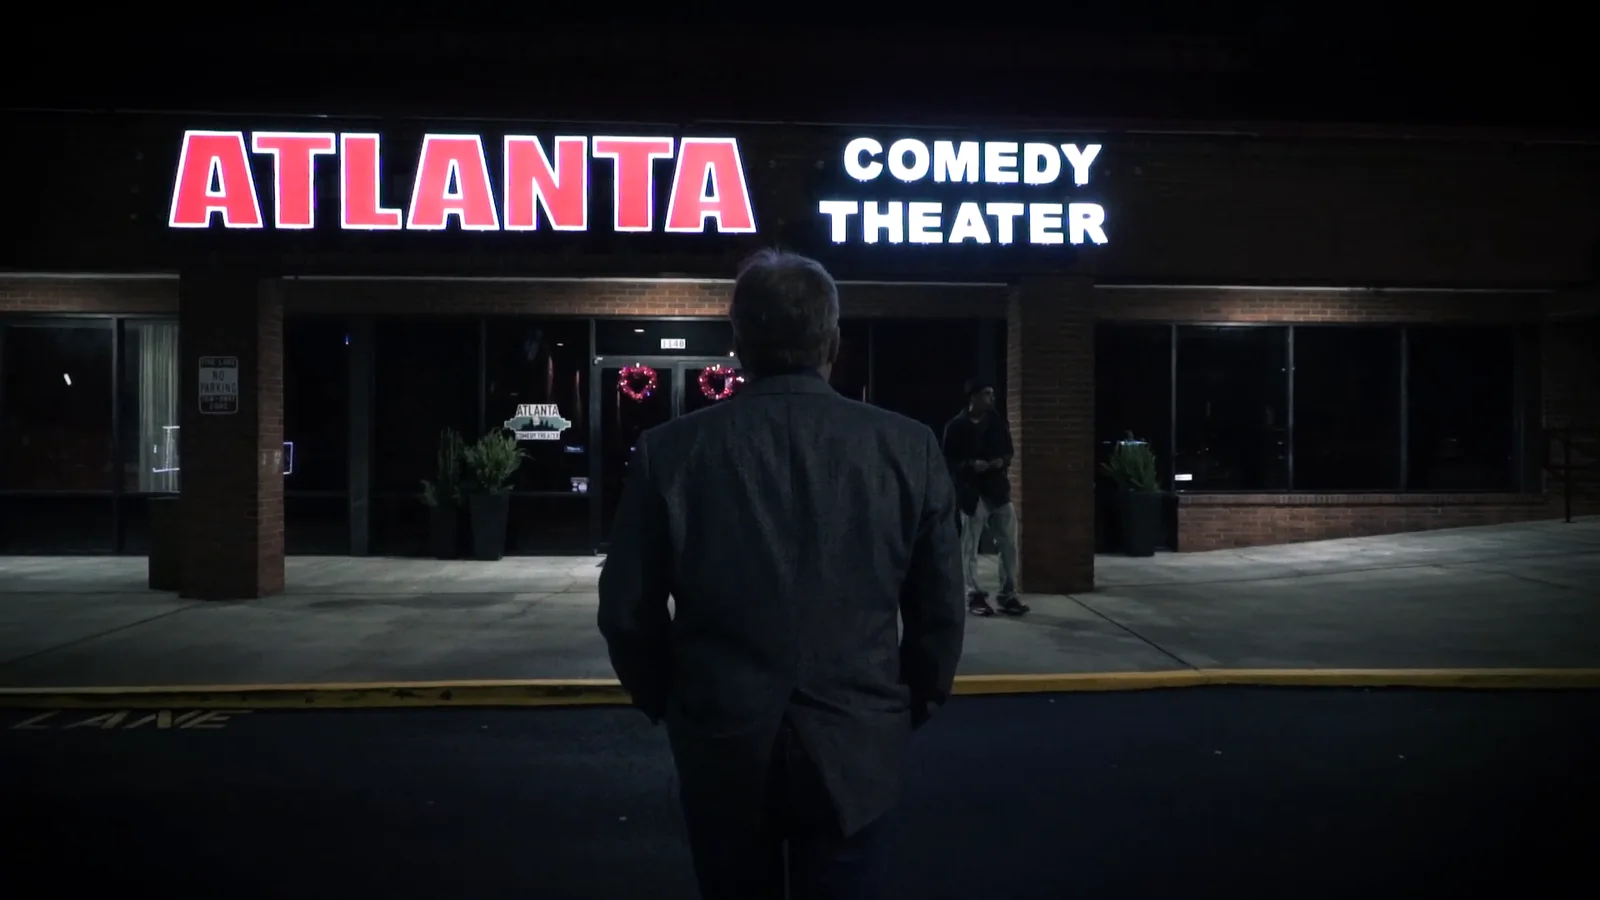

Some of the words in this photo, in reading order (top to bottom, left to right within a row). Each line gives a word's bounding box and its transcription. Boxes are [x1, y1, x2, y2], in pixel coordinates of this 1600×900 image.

[843, 137, 1102, 186] COMEDY
[168, 129, 757, 234] ATLANTA
[818, 200, 1109, 245] THEATER
[212, 370, 225, 381] NO
[200, 382, 237, 393] PARKING
[516, 405, 558, 416] ATLANTA
[9, 709, 254, 730] LANE
